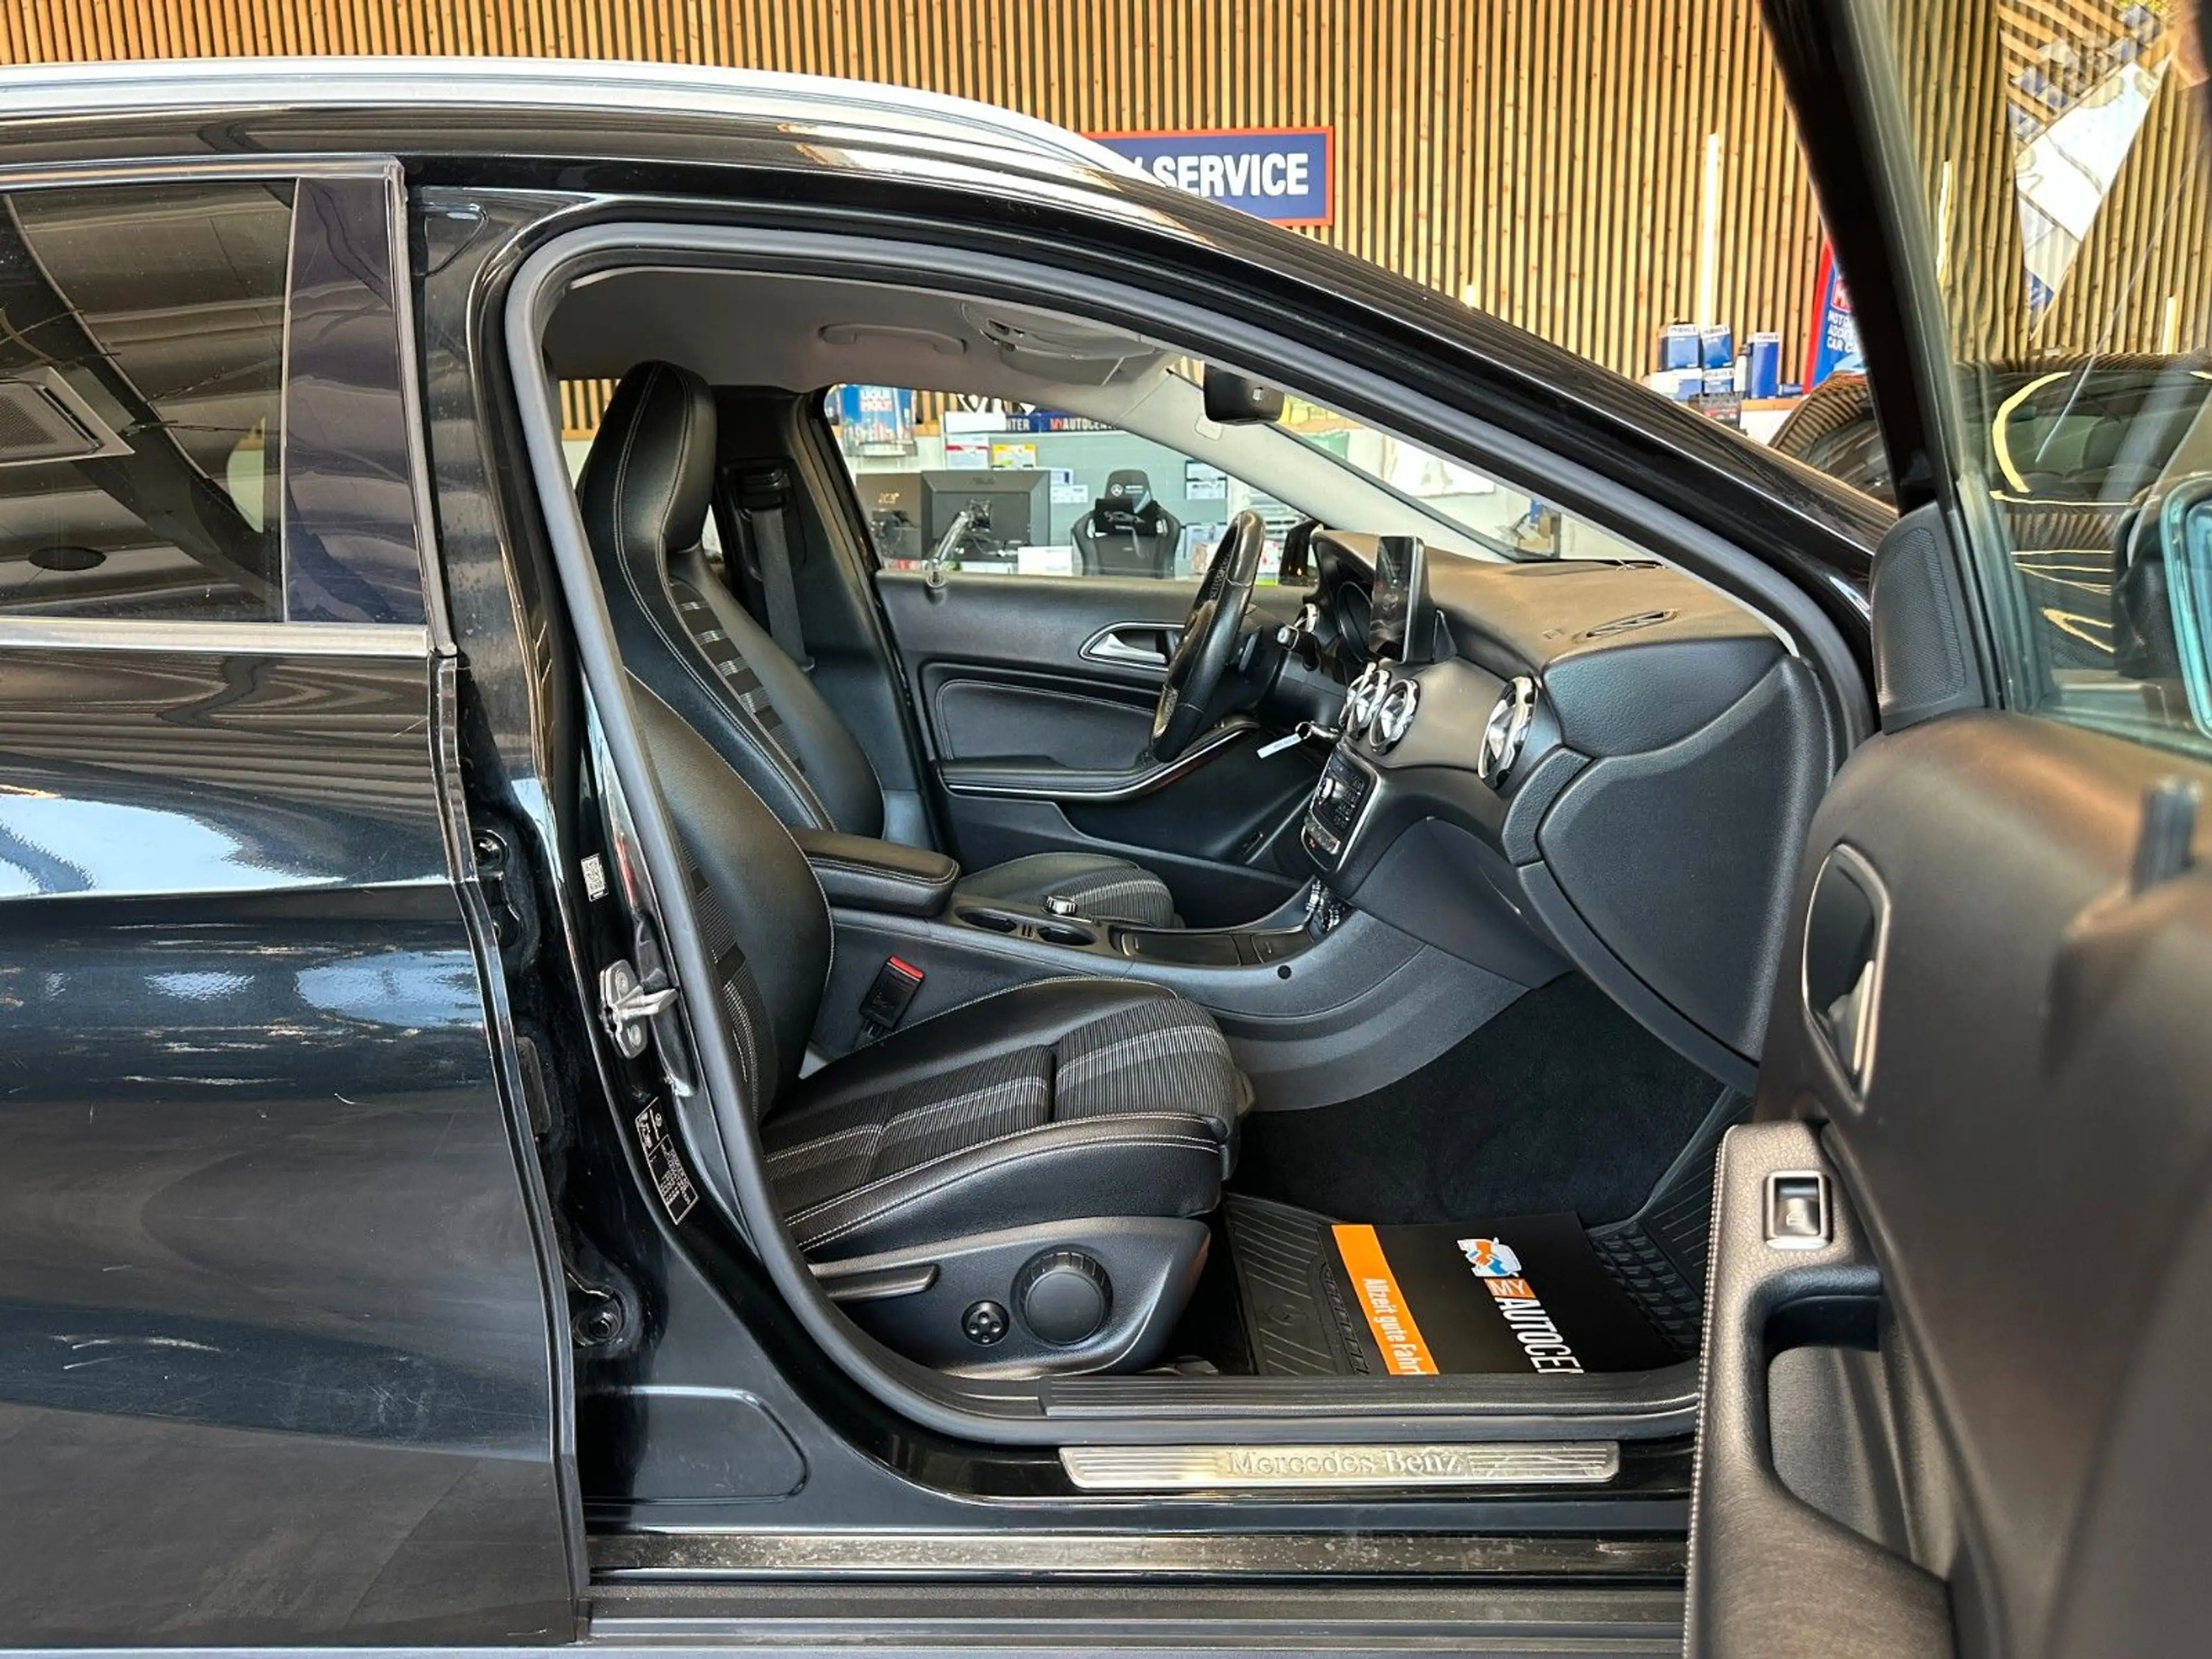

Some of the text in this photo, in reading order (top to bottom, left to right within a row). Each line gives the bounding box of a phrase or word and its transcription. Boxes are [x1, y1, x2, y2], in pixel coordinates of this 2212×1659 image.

[1153, 153, 1309, 197] SERVICE
[1363, 1278, 1398, 1313] Allzeit
[1486, 1279, 1527, 1296] MY
[1373, 1316, 1408, 1342] gute
